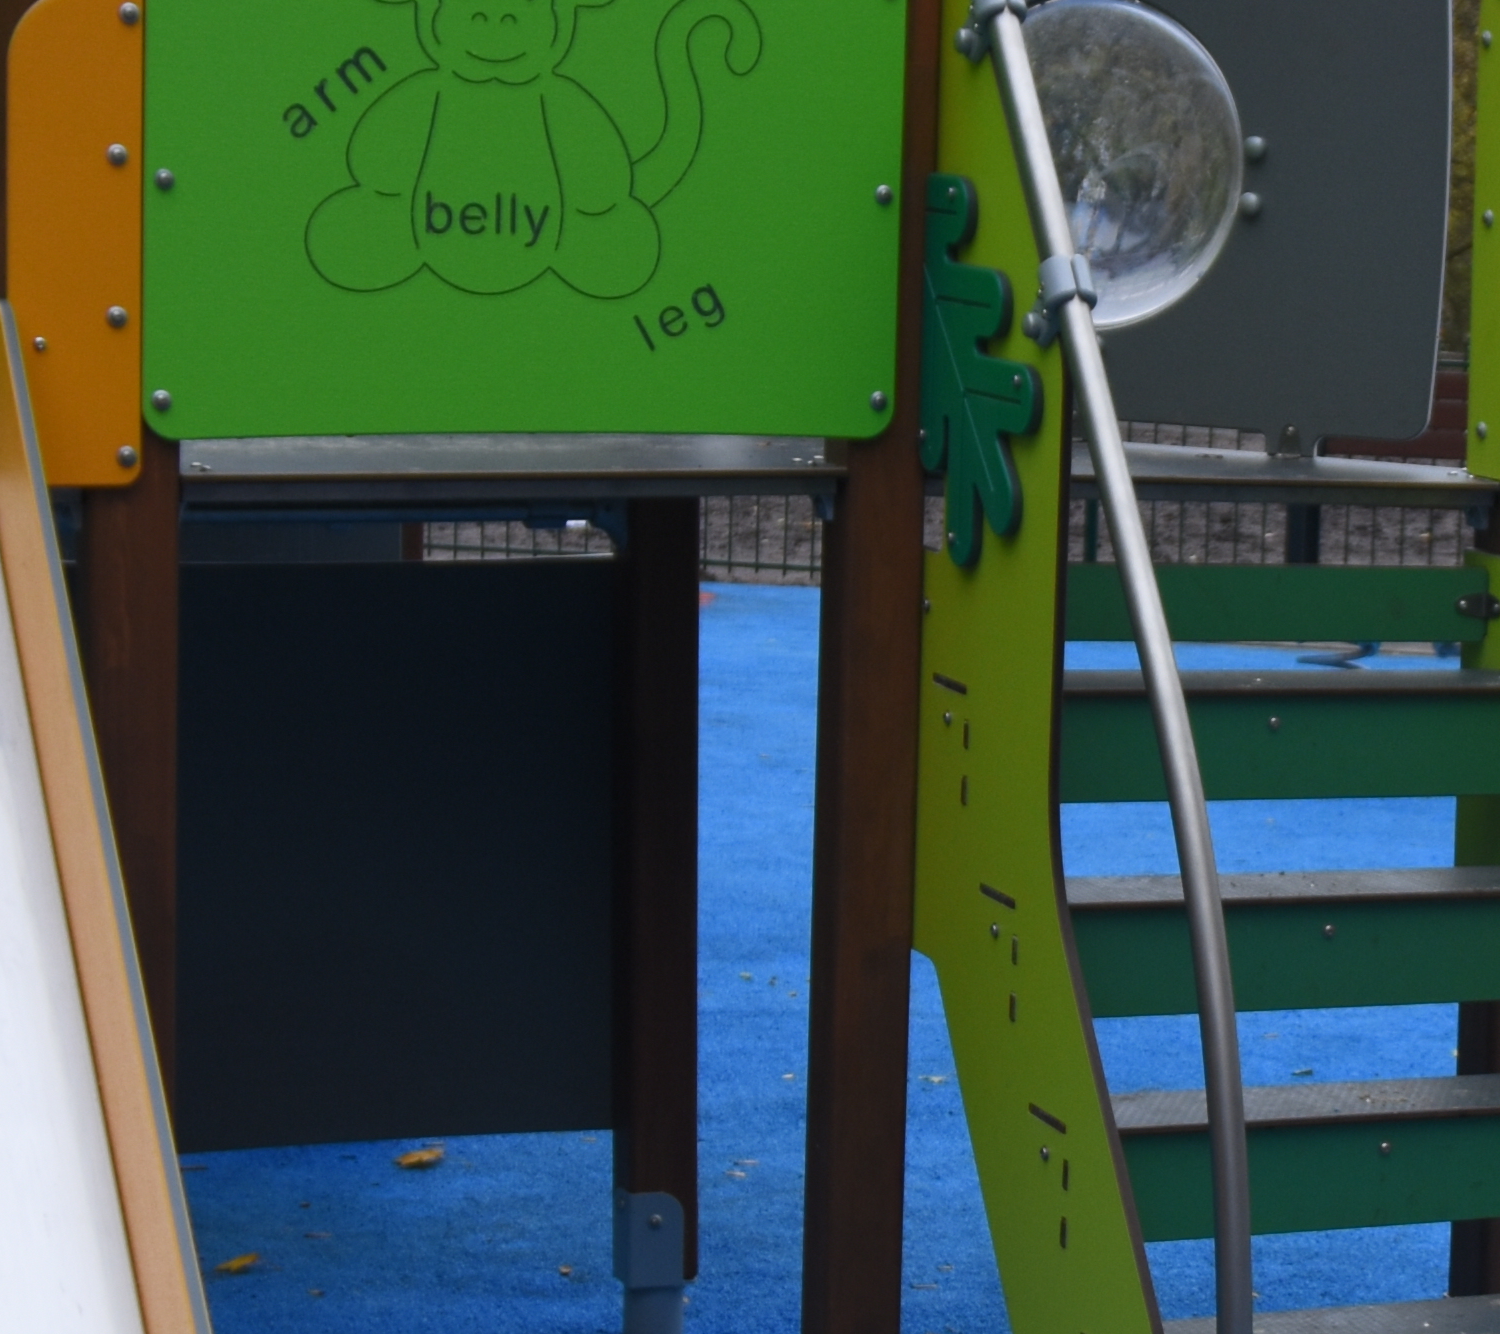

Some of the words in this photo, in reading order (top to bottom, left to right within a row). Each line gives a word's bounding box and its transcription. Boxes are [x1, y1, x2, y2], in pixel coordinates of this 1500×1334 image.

[281, 44, 388, 140] arm
[423, 191, 550, 248] belly
[633, 282, 728, 353] leg
